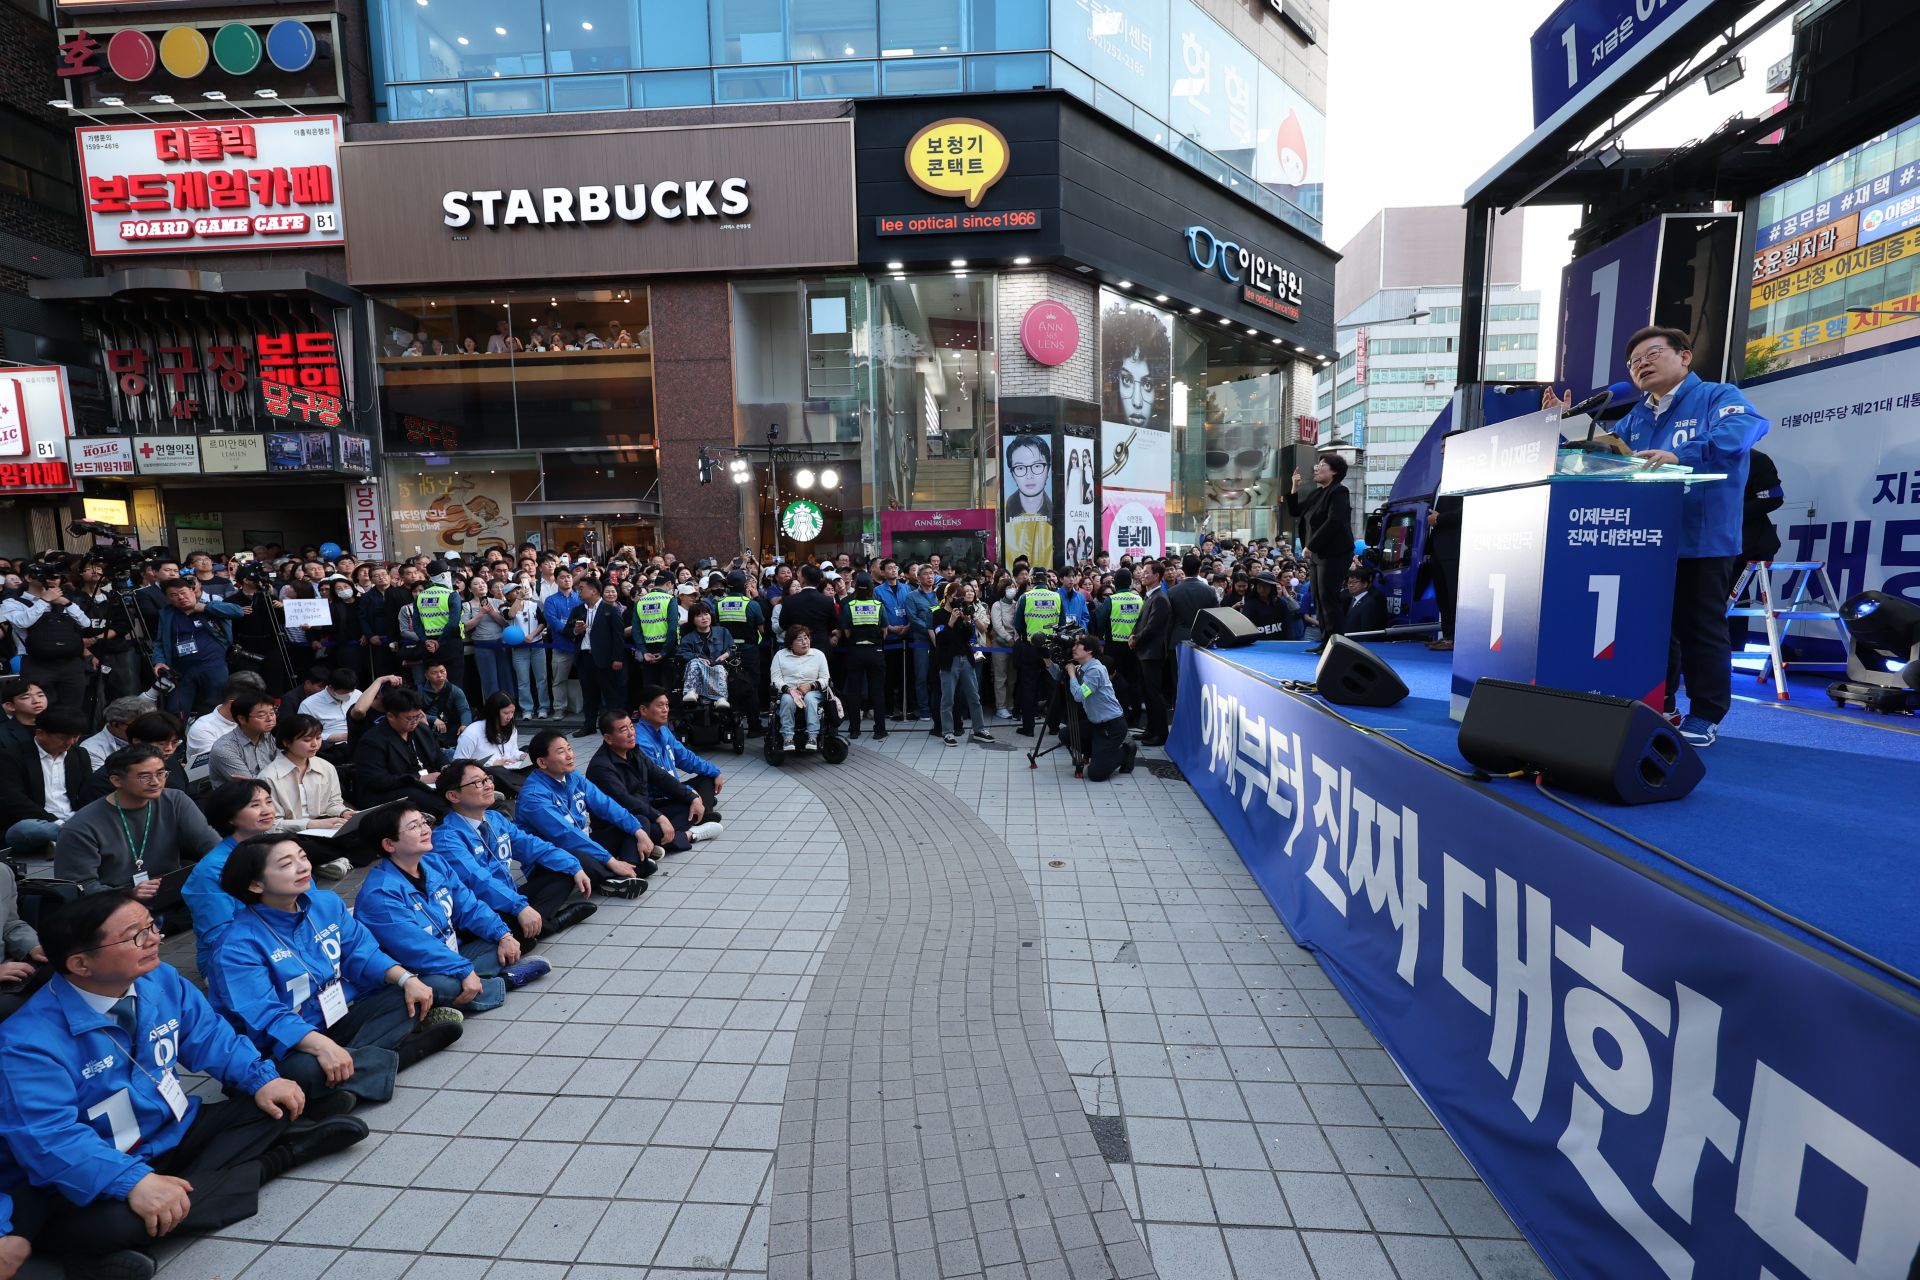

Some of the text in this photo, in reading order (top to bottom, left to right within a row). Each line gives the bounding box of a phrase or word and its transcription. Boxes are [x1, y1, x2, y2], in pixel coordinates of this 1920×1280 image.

[1591, 15, 1634, 67] 지금은
[1562, 22, 1578, 89] 1
[154, 125, 257, 162] 더홀릭
[926, 134, 983, 154] 보청기
[927, 157, 984, 177] 콘택트
[89, 165, 335, 213] 보드게임카페
[442, 177, 749, 229] STARBUCKS
[121, 215, 304, 237] BOARD GAME CAFE
[317, 214, 333, 228] B1
[881, 211, 1036, 232] lee optical since1966
[1752, 227, 1838, 281] 조운행치과
[1239, 248, 1302, 305] 이안경원
[1255, 293, 1274, 308] optical
[1039, 321, 1063, 331] ANN
[1591, 259, 1620, 390] 1
[257, 332, 337, 366] 보드
[1038, 340, 1065, 349] LENS
[108, 345, 252, 396] 당구장
[171, 399, 200, 420] 4F
[262, 379, 342, 428] 당구장
[1781, 405, 1849, 428] 더불어민주당
[1851, 397, 1893, 416] 제21대
[1674, 418, 1698, 428] 지금은
[38, 443, 53, 455] B1
[83, 443, 118, 457] HOLIC
[155, 444, 195, 456] 헌혈의집
[208, 439, 257, 450] 르미안헤어
[1500, 440, 1541, 469] 이재명
[74, 461, 133, 472] 보드게임카페
[355, 487, 378, 550] 당구장
[914, 519, 932, 528] ANN
[942, 518, 962, 526] LENS
[1069, 510, 1090, 518] CARIN
[1568, 507, 1631, 526] 이제부터
[1567, 528, 1664, 547] 진짜 대한민국
[1488, 573, 1506, 650] 1
[1588, 574, 1620, 659] 1
[1200, 683, 1304, 857] 이제부터
[1304, 753, 1428, 988] 진짜
[314, 923, 340, 944] 지금은
[148, 1018, 180, 1042] 지금은
[81, 1055, 114, 1080] 민주당
[87, 1087, 142, 1154] 1
